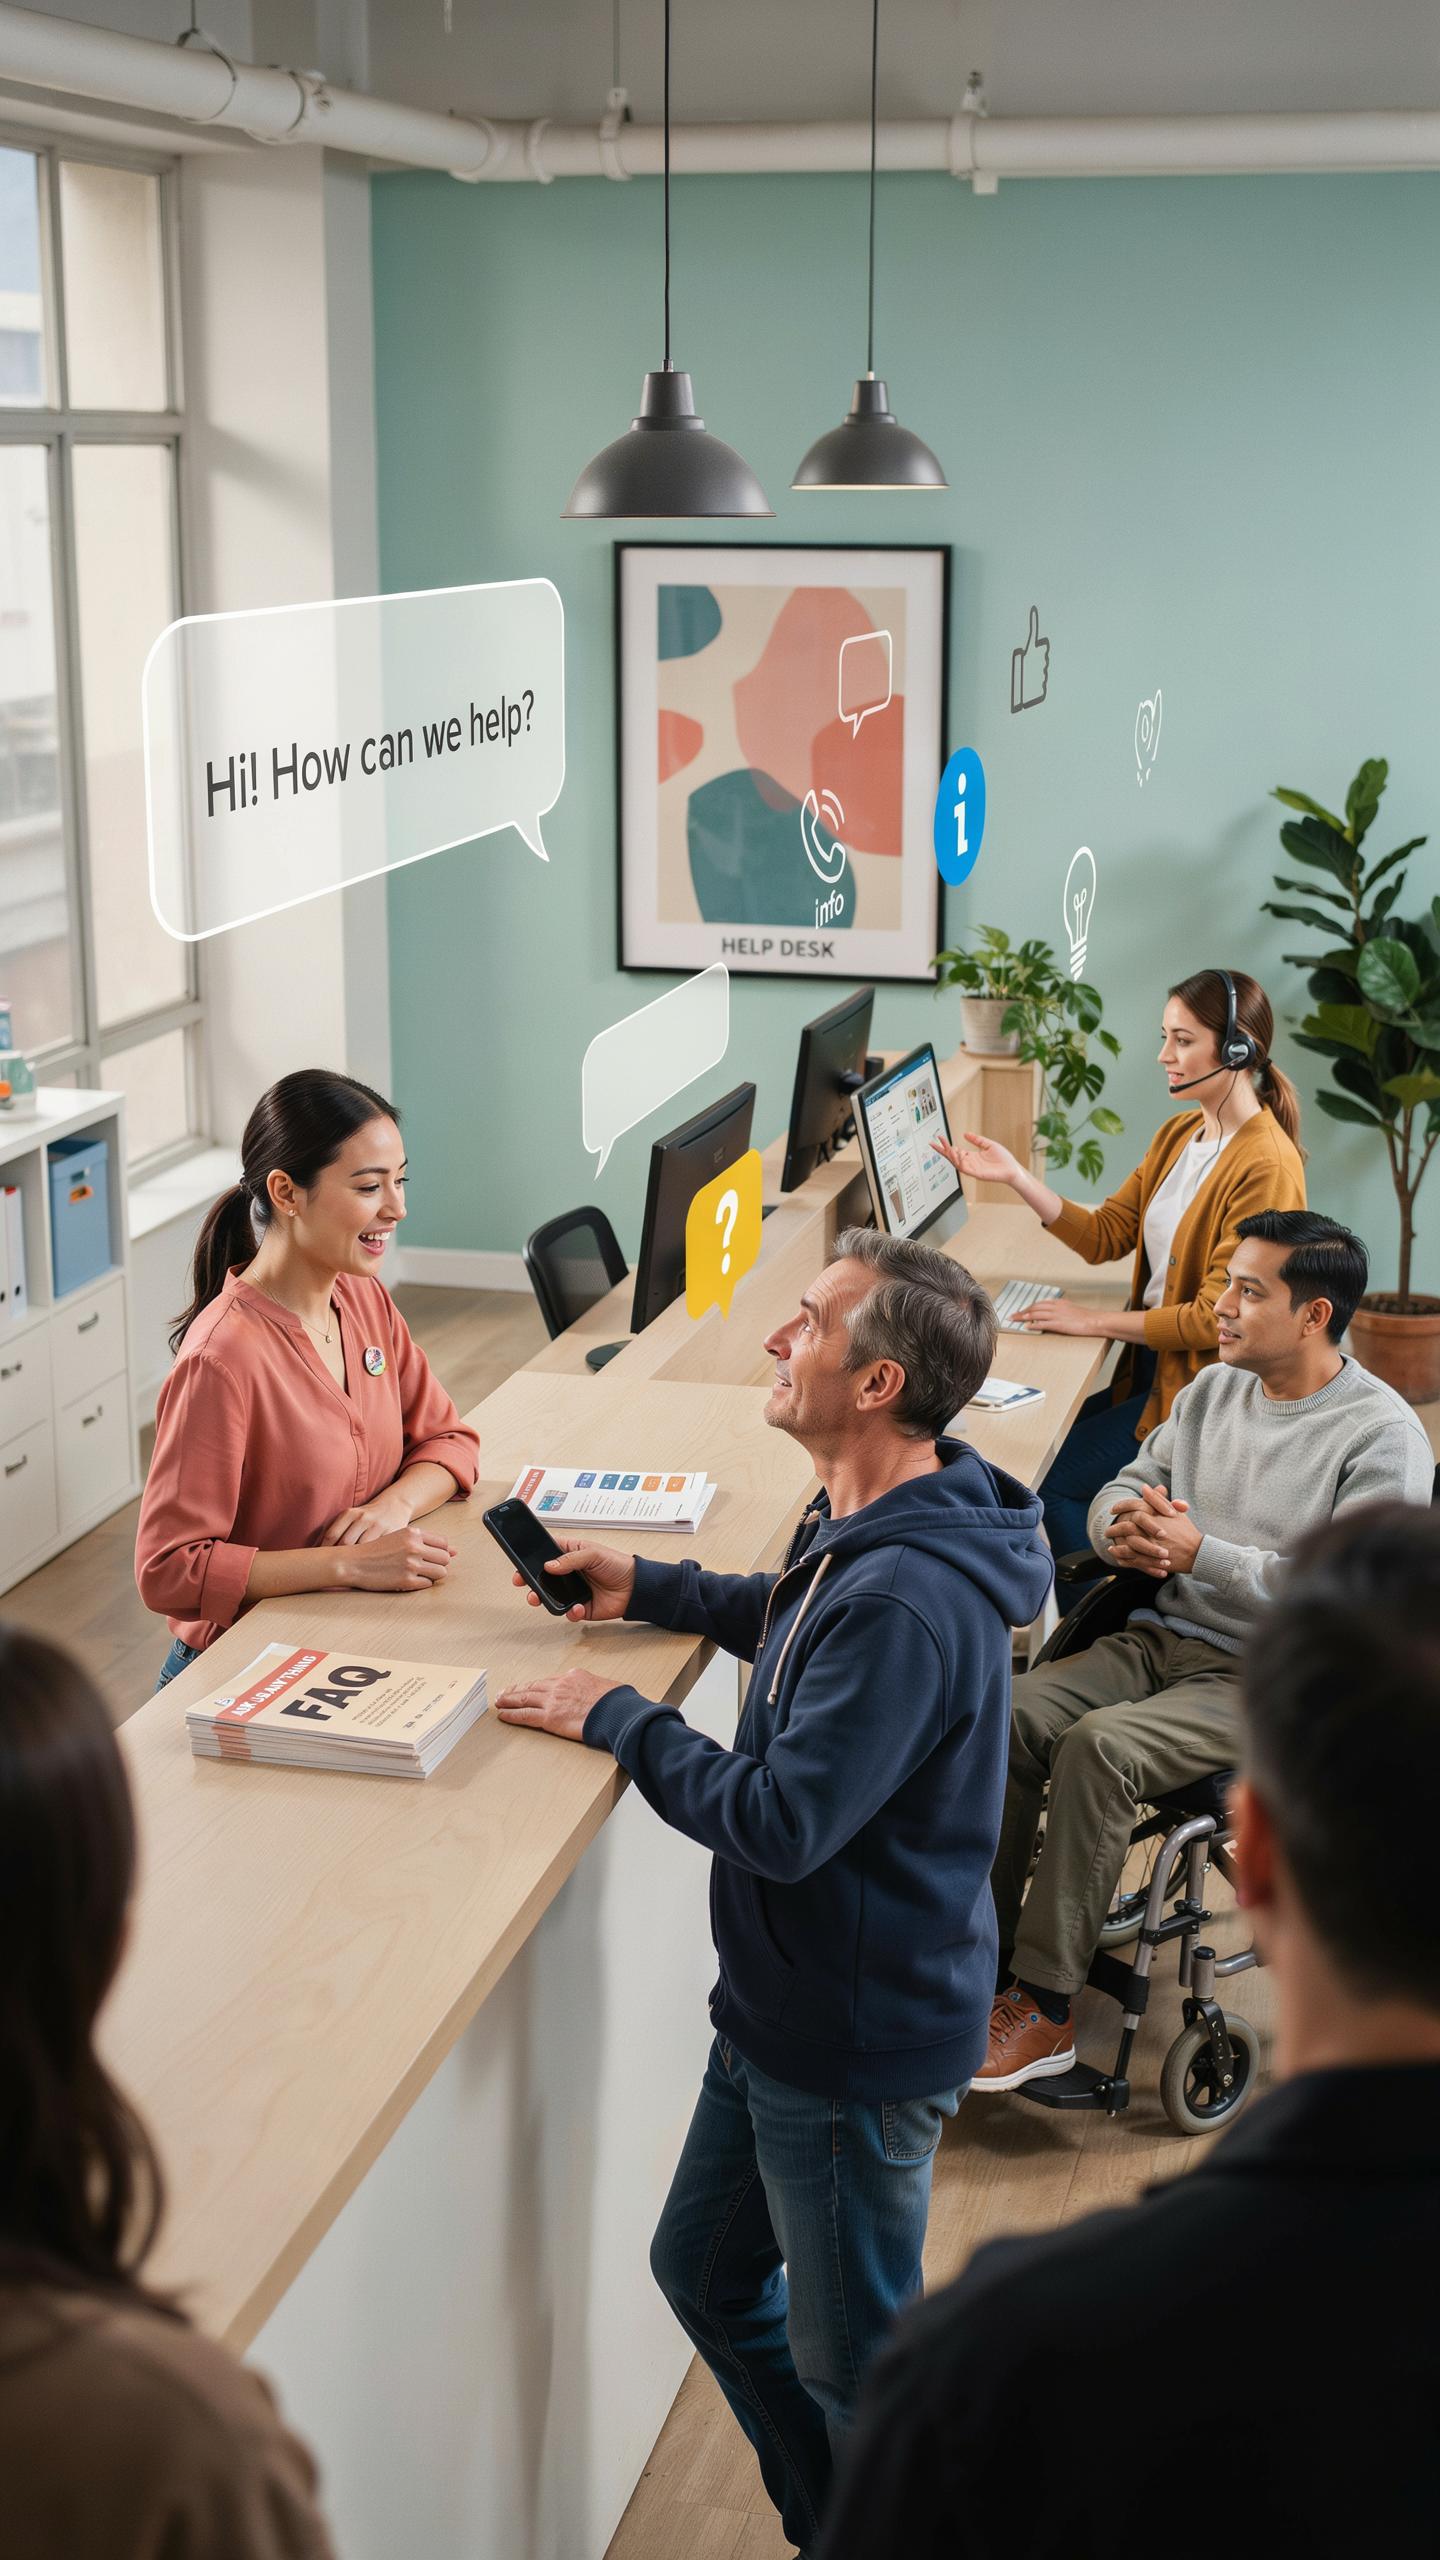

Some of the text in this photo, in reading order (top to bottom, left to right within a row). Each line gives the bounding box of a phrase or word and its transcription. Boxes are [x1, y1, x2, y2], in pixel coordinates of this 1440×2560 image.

[721, 937, 836, 959] HELP DESK
[279, 1665, 392, 1721] FAQ
